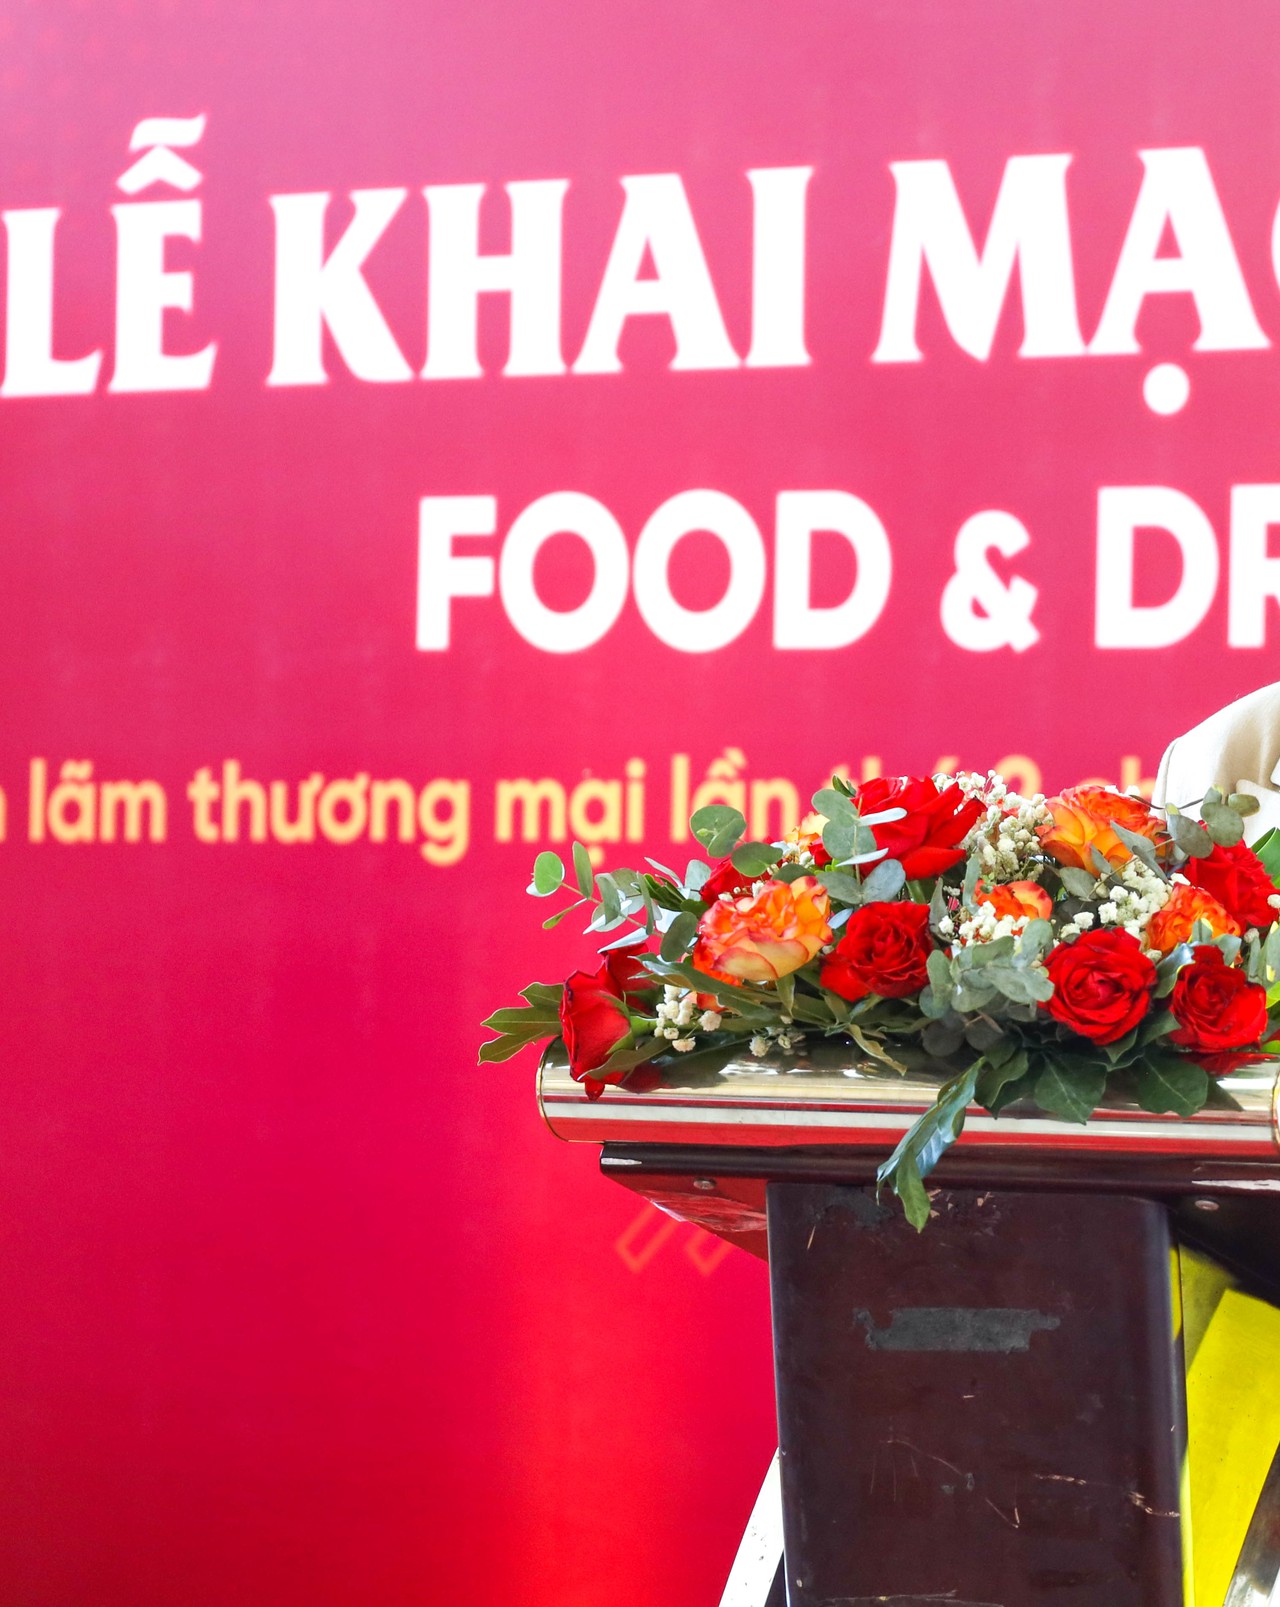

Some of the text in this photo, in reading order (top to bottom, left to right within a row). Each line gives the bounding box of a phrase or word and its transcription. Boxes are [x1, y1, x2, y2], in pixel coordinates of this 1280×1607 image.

[0, 113, 217, 397] LỄ
[266, 165, 814, 387] KHAI
[415, 488, 893, 654] FOOD
[940, 509, 1040, 653] &
[29, 757, 167, 843] lãm
[187, 759, 470, 866] thương
[496, 756, 647, 866] mại
